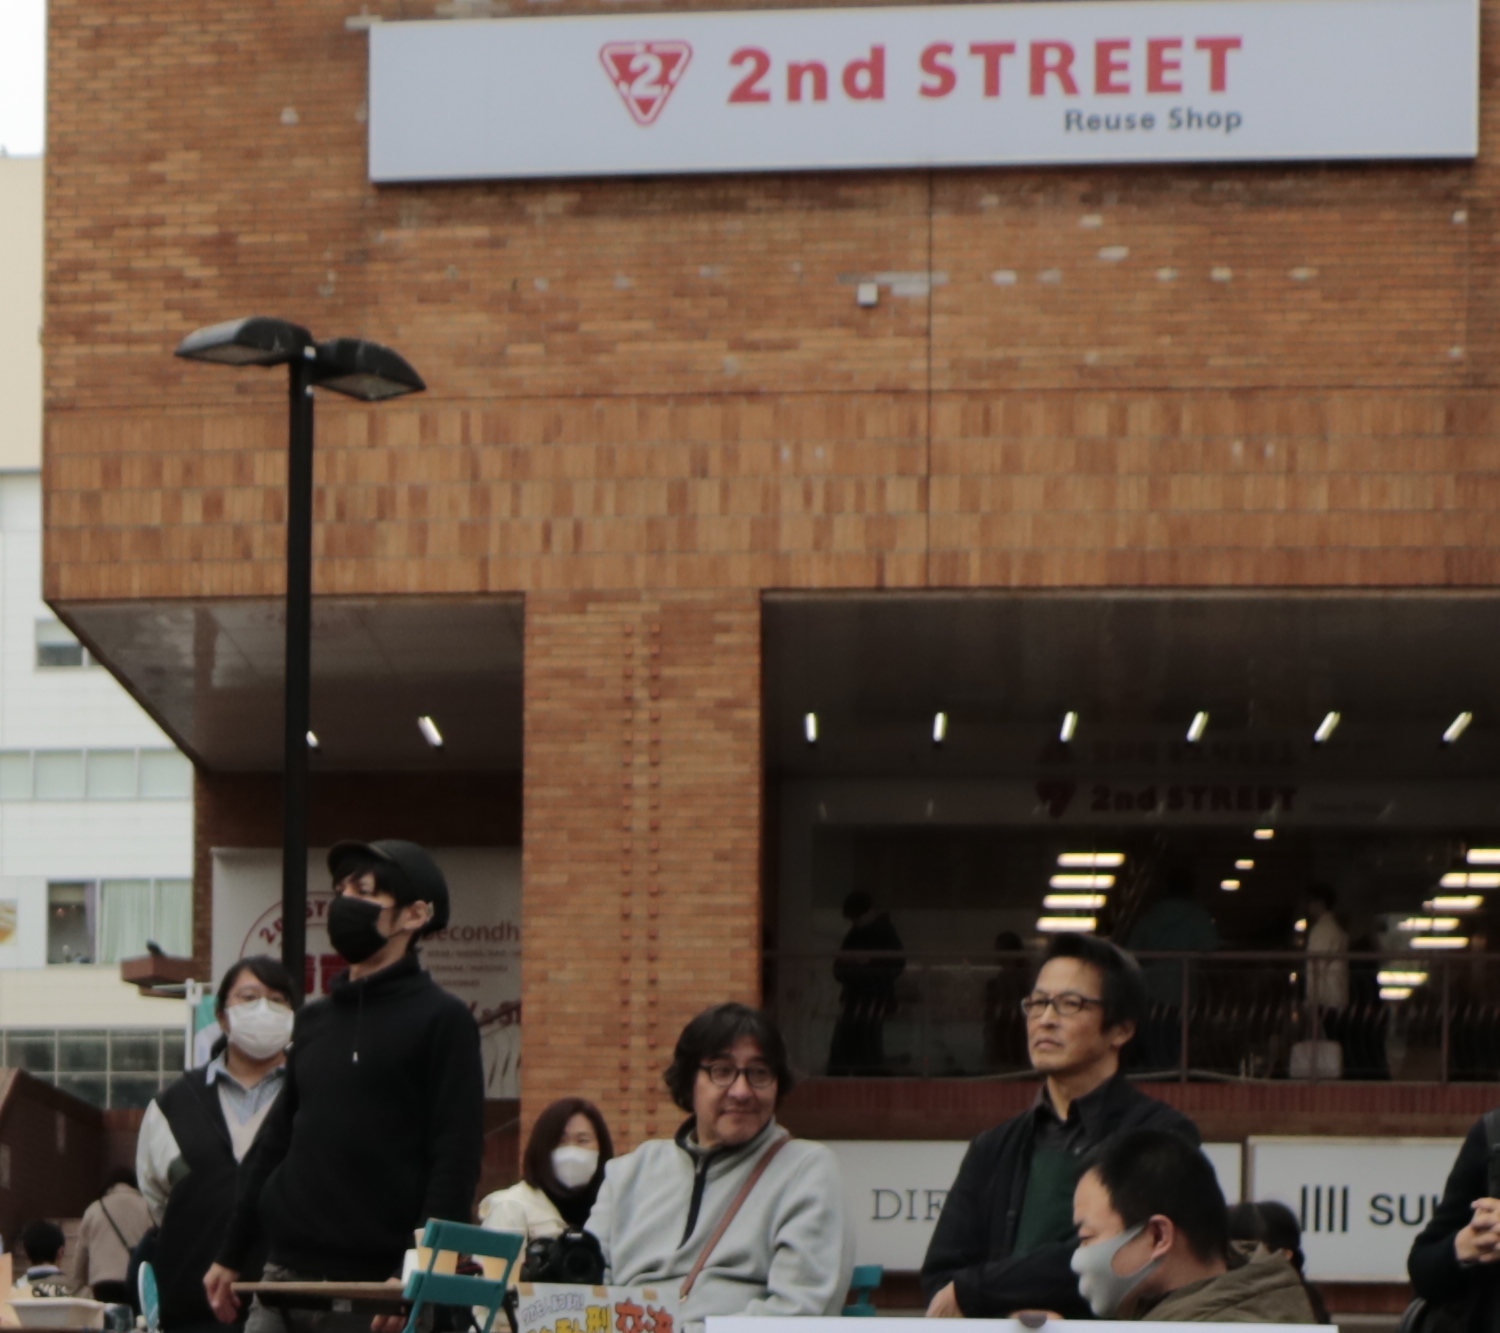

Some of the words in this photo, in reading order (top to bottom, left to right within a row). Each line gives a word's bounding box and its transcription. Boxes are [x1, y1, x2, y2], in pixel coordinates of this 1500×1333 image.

[726, 45, 887, 104] 2nd
[917, 36, 1243, 98] STREET
[1063, 108, 1157, 133] Reuse
[1168, 106, 1243, 136] Shop
[1091, 783, 1158, 812] 2nd
[1167, 784, 1299, 812] STREET
